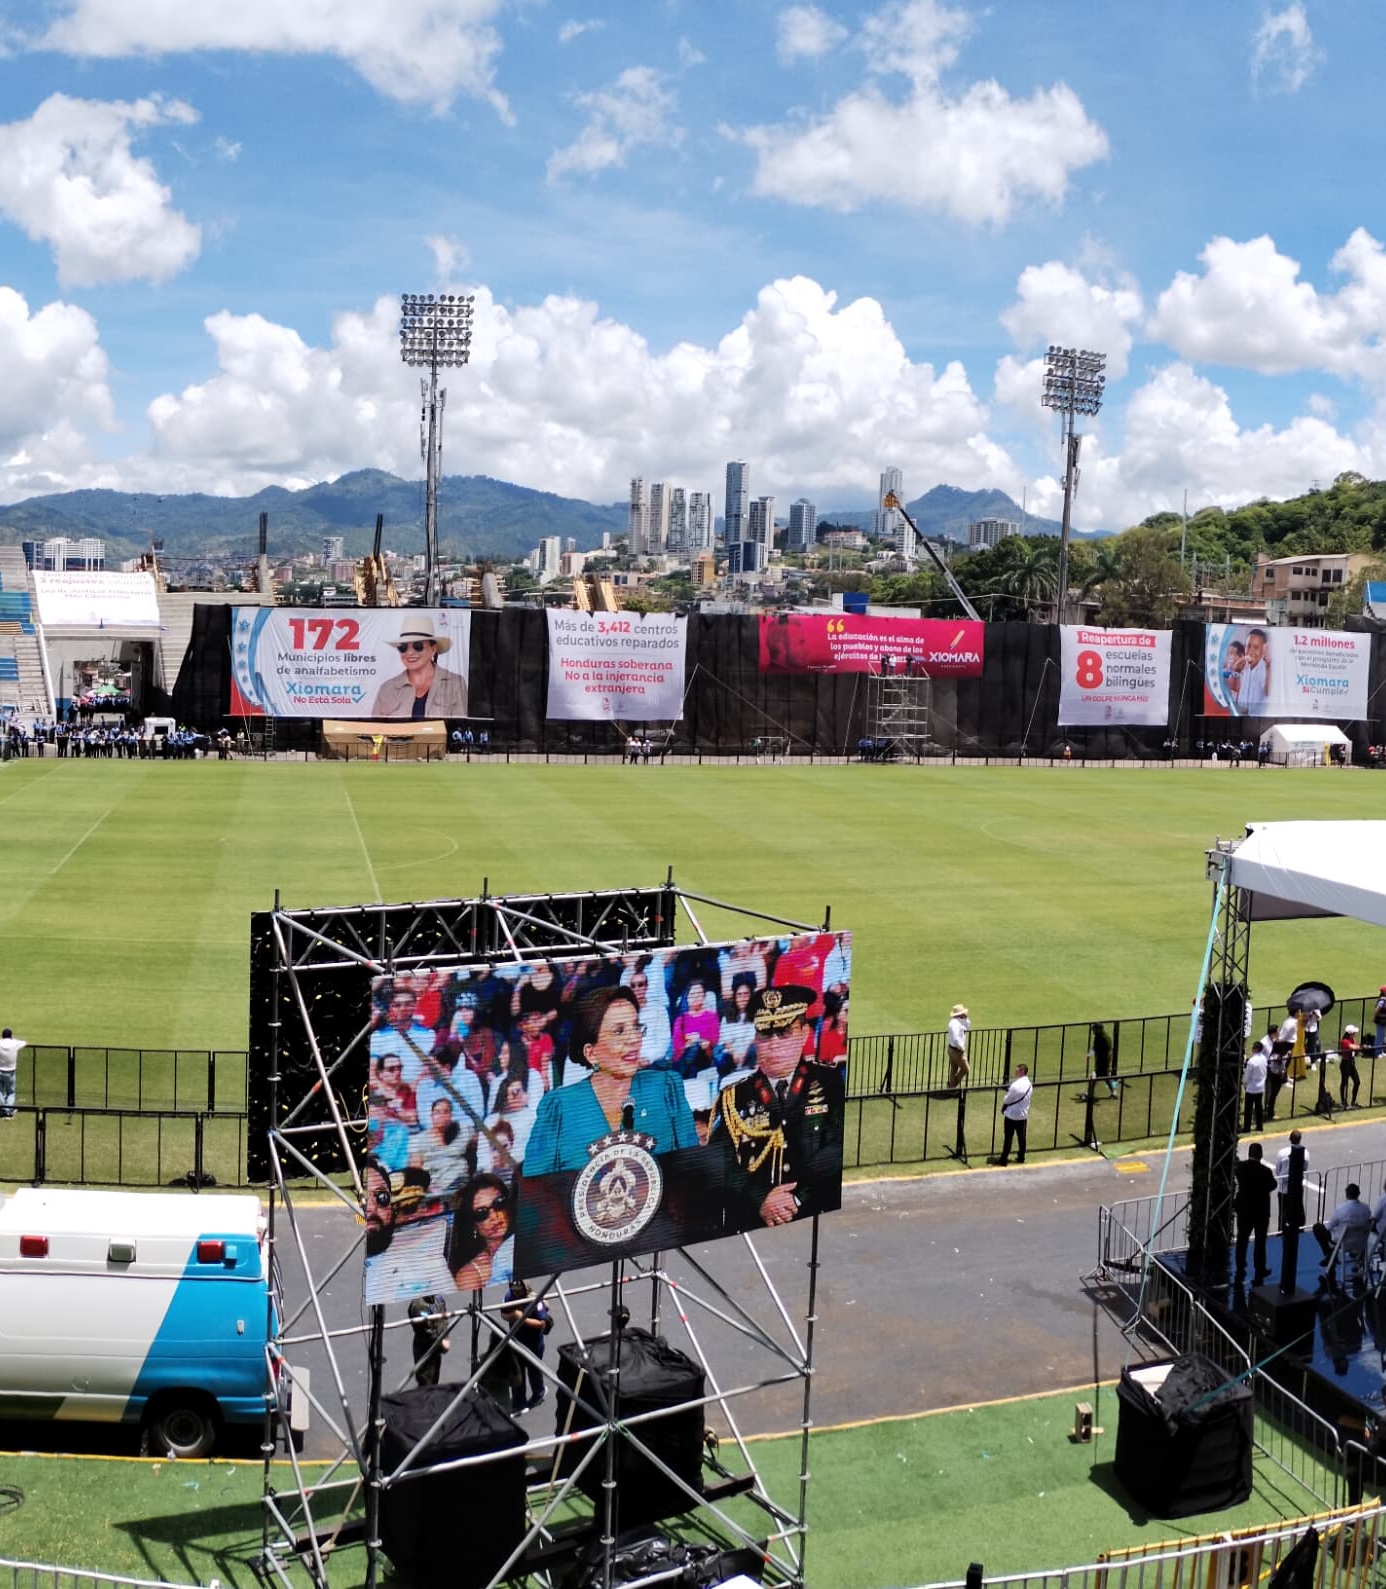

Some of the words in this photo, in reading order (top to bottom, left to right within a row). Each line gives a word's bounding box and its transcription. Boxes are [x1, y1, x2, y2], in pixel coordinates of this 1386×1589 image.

[555, 619, 577, 632] Más
[580, 621, 595, 632] de
[598, 621, 631, 635] 3,412
[634, 624, 678, 635] centros
[289, 618, 360, 650] 172
[827, 633, 837, 641] La
[838, 632, 879, 642] educación
[915, 636, 925, 644] de
[1081, 632, 1137, 646] Reapertura
[1139, 636, 1152, 645] de
[556, 634, 619, 647] educativos
[621, 637, 680, 650] reparados
[1294, 635, 1308, 646] 1.2
[1310, 636, 1355, 649] millones
[830, 643, 841, 651] los
[842, 643, 873, 652] pueblos
[879, 645, 902, 653] abono
[902, 645, 912, 653] de
[912, 645, 924, 654] los
[277, 653, 341, 664] Municipios
[343, 653, 376, 663] libres
[869, 653, 879, 661] de
[929, 651, 981, 663] XIOMARA
[1106, 650, 1153, 661] escuelas
[560, 658, 616, 669] Honduras
[618, 659, 673, 671] soberana
[1076, 650, 1103, 689] 8
[1106, 664, 1157, 675] normales
[276, 666, 291, 675] de
[294, 666, 377, 676] analfabetismo
[565, 671, 580, 681] No
[582, 673, 589, 681] a
[593, 671, 603, 681] la
[1106, 676, 1156, 690] bilingües
[1297, 674, 1350, 688] Xiomara
[286, 681, 361, 695] Xiomara
[585, 683, 646, 695] extranjera
[1310, 686, 1345, 696] Cumple
[294, 696, 306, 704] No
[332, 696, 351, 704] Sola
[588, 1219, 643, 1239] HONDURAS
